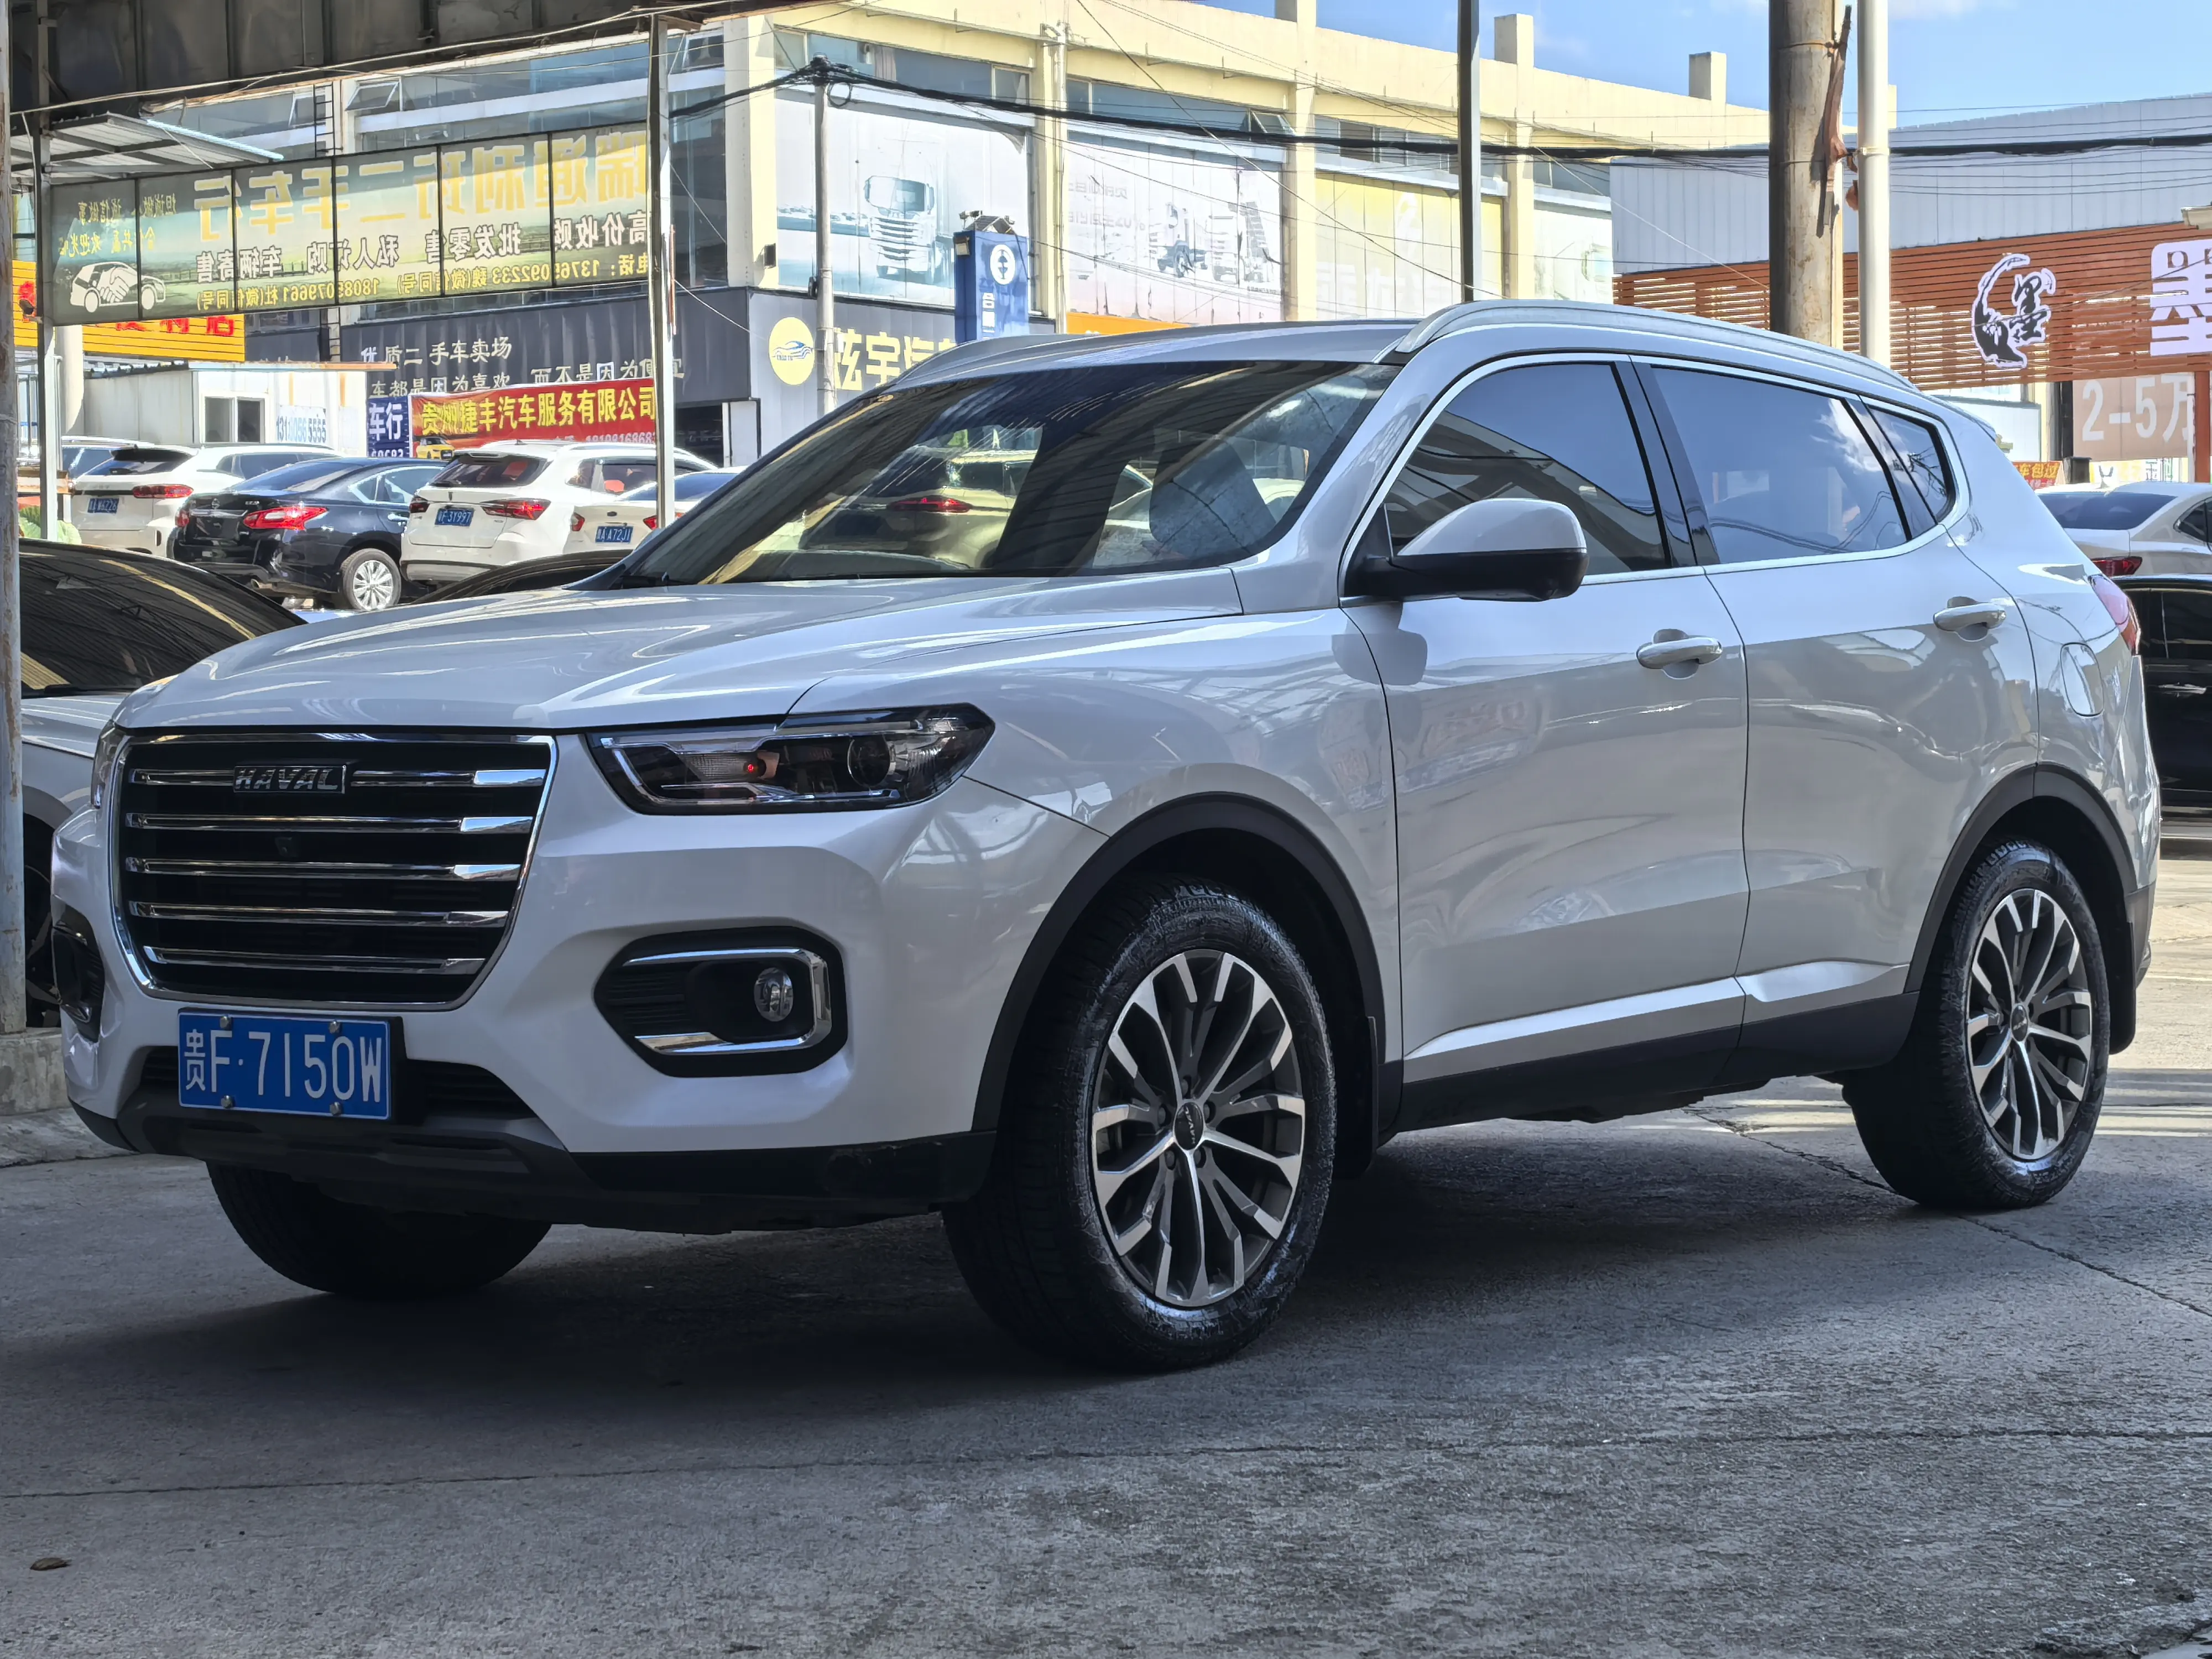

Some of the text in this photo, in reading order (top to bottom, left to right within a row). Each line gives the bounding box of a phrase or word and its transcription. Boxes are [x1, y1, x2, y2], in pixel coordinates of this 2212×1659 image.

[361, 336, 512, 366] 优质二手车卖场
[834, 329, 956, 391] 炫宇汽
[369, 402, 403, 441] 车行
[421, 387, 655, 436] 贵州捷丰汽车服务有限公司
[236, 769, 338, 790] HAVAL
[184, 1029, 382, 1102] 贵F·7150W
